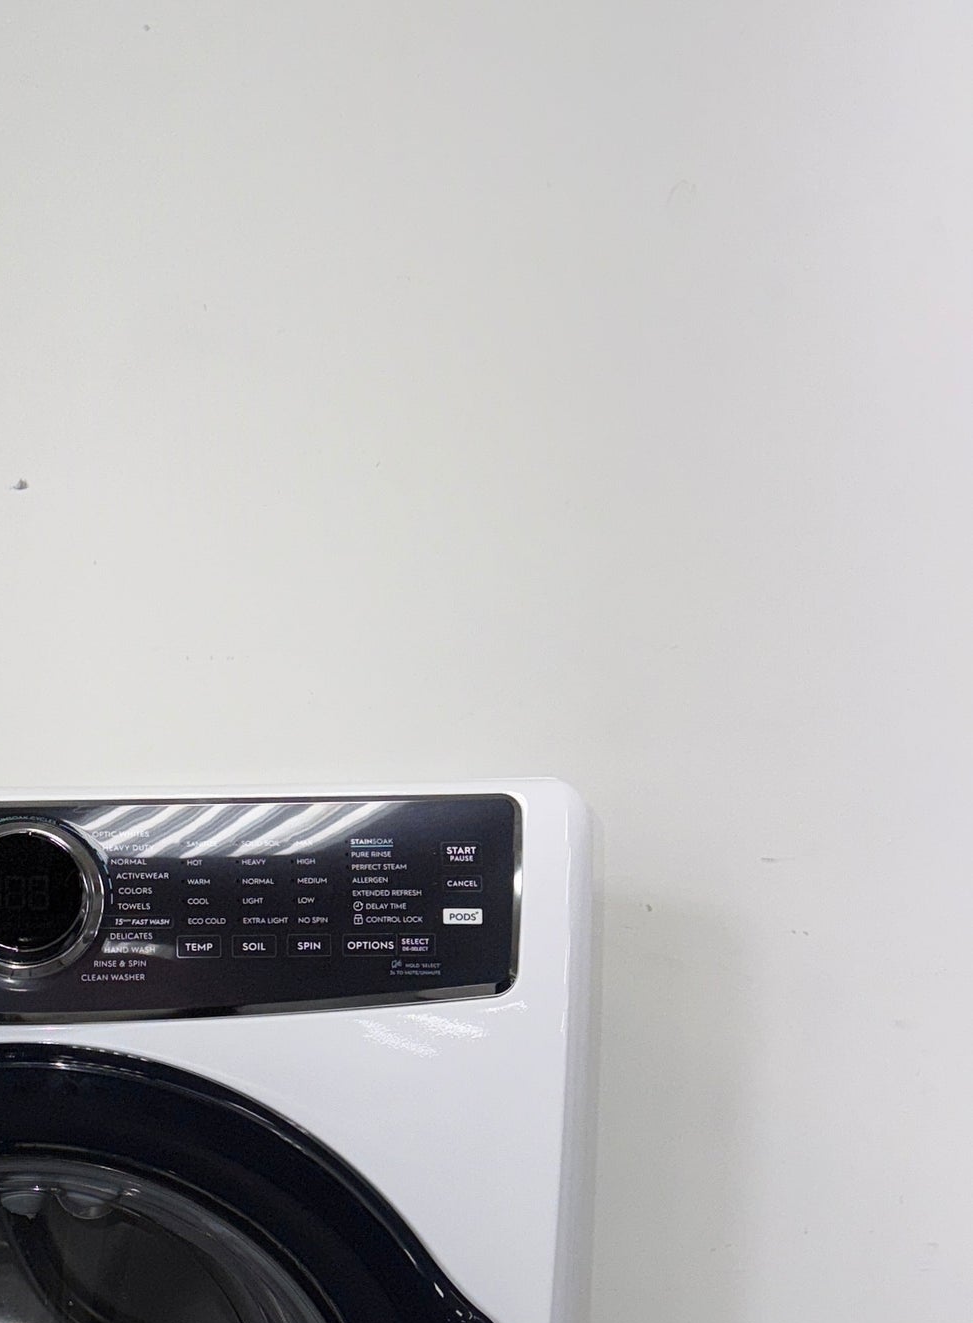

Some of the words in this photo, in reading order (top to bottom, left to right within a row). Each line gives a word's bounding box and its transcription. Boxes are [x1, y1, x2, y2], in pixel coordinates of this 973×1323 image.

[446, 846, 476, 855] START
[110, 858, 147, 866] NORMAL
[116, 872, 170, 880] ACTIVEWEAR
[352, 876, 389, 884] ALLERGEN
[118, 887, 153, 895] COLORS
[205, 917, 226, 925] COLD
[110, 932, 153, 940] DELICATES
[185, 942, 213, 951] TEMP
[242, 942, 266, 951] SOIL
[297, 941, 321, 950] SPIN
[347, 941, 394, 950] OPTIONS
[81, 974, 108, 982] CLEAN
[110, 973, 146, 981] WASHER
